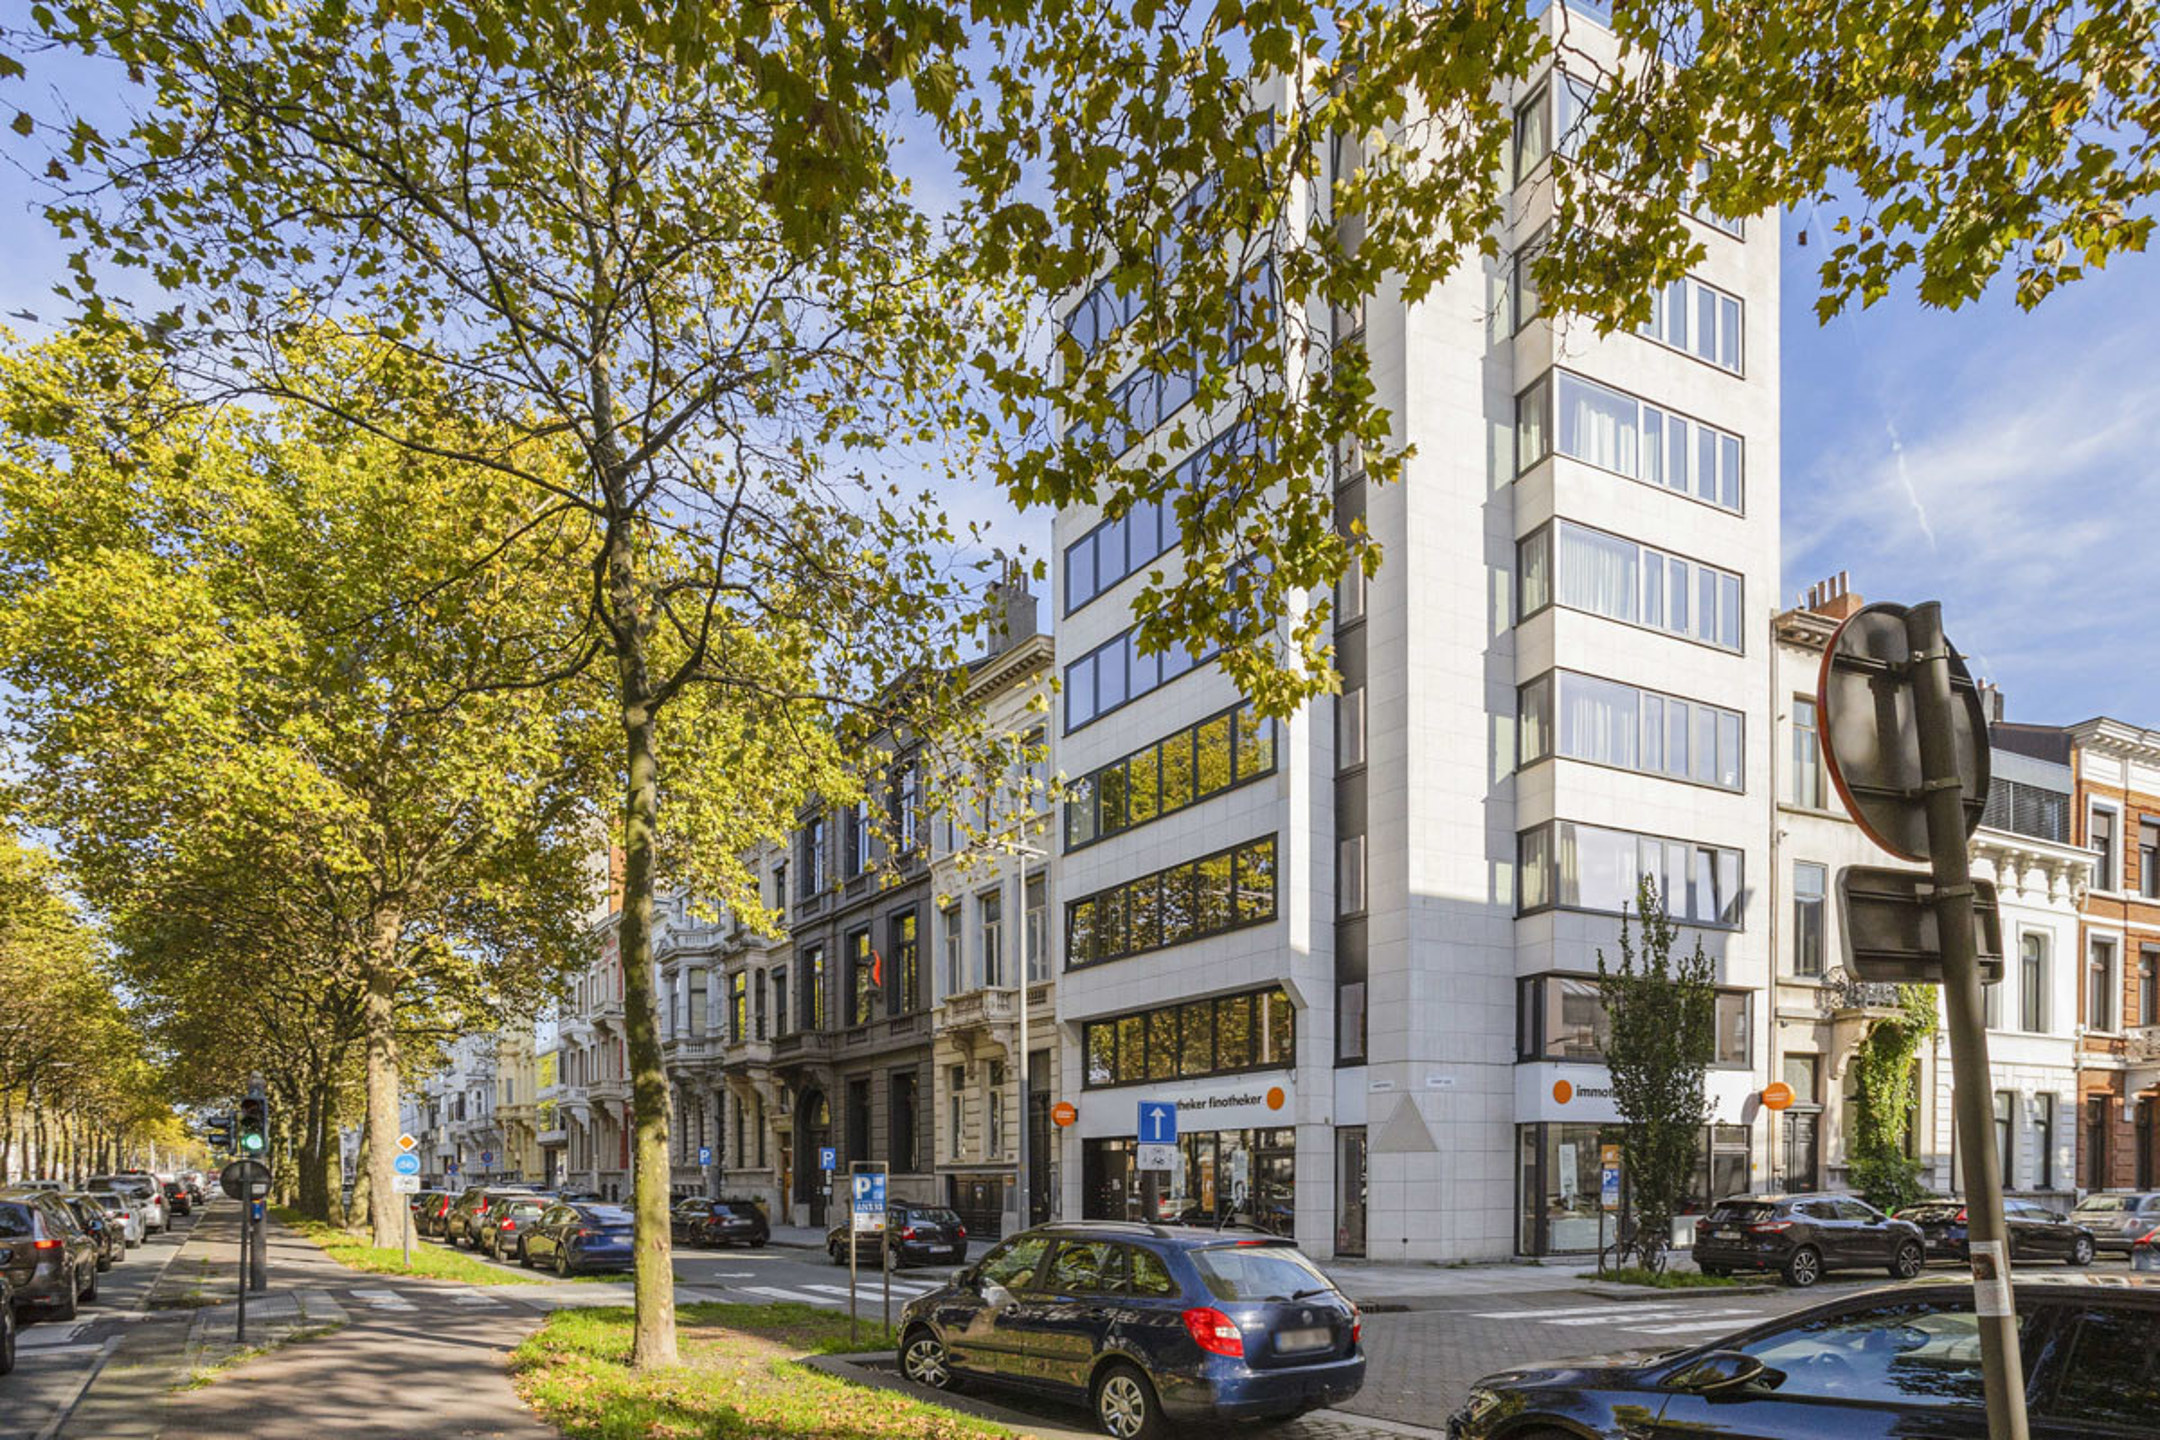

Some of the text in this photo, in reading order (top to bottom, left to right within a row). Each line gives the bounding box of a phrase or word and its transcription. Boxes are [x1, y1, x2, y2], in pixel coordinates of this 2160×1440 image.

[1576, 1084, 1615, 1098] immot
[823, 1151, 834, 1167] P
[856, 1176, 872, 1200] P
